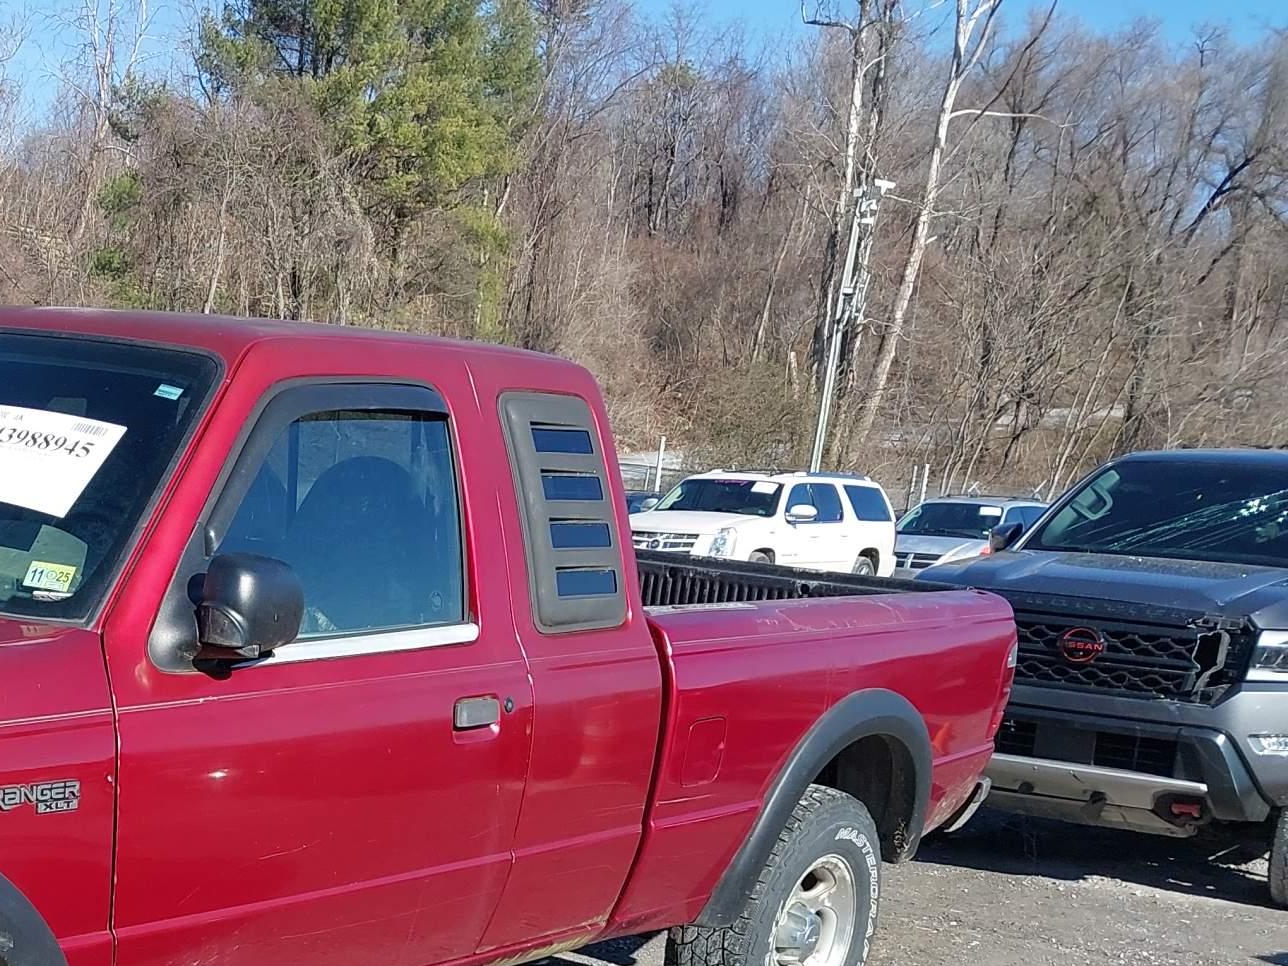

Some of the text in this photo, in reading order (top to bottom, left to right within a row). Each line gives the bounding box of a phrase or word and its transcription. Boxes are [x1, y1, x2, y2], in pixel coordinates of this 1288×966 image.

[31, 567, 71, 583] 11 25
[40, 800, 75, 812] XLT
